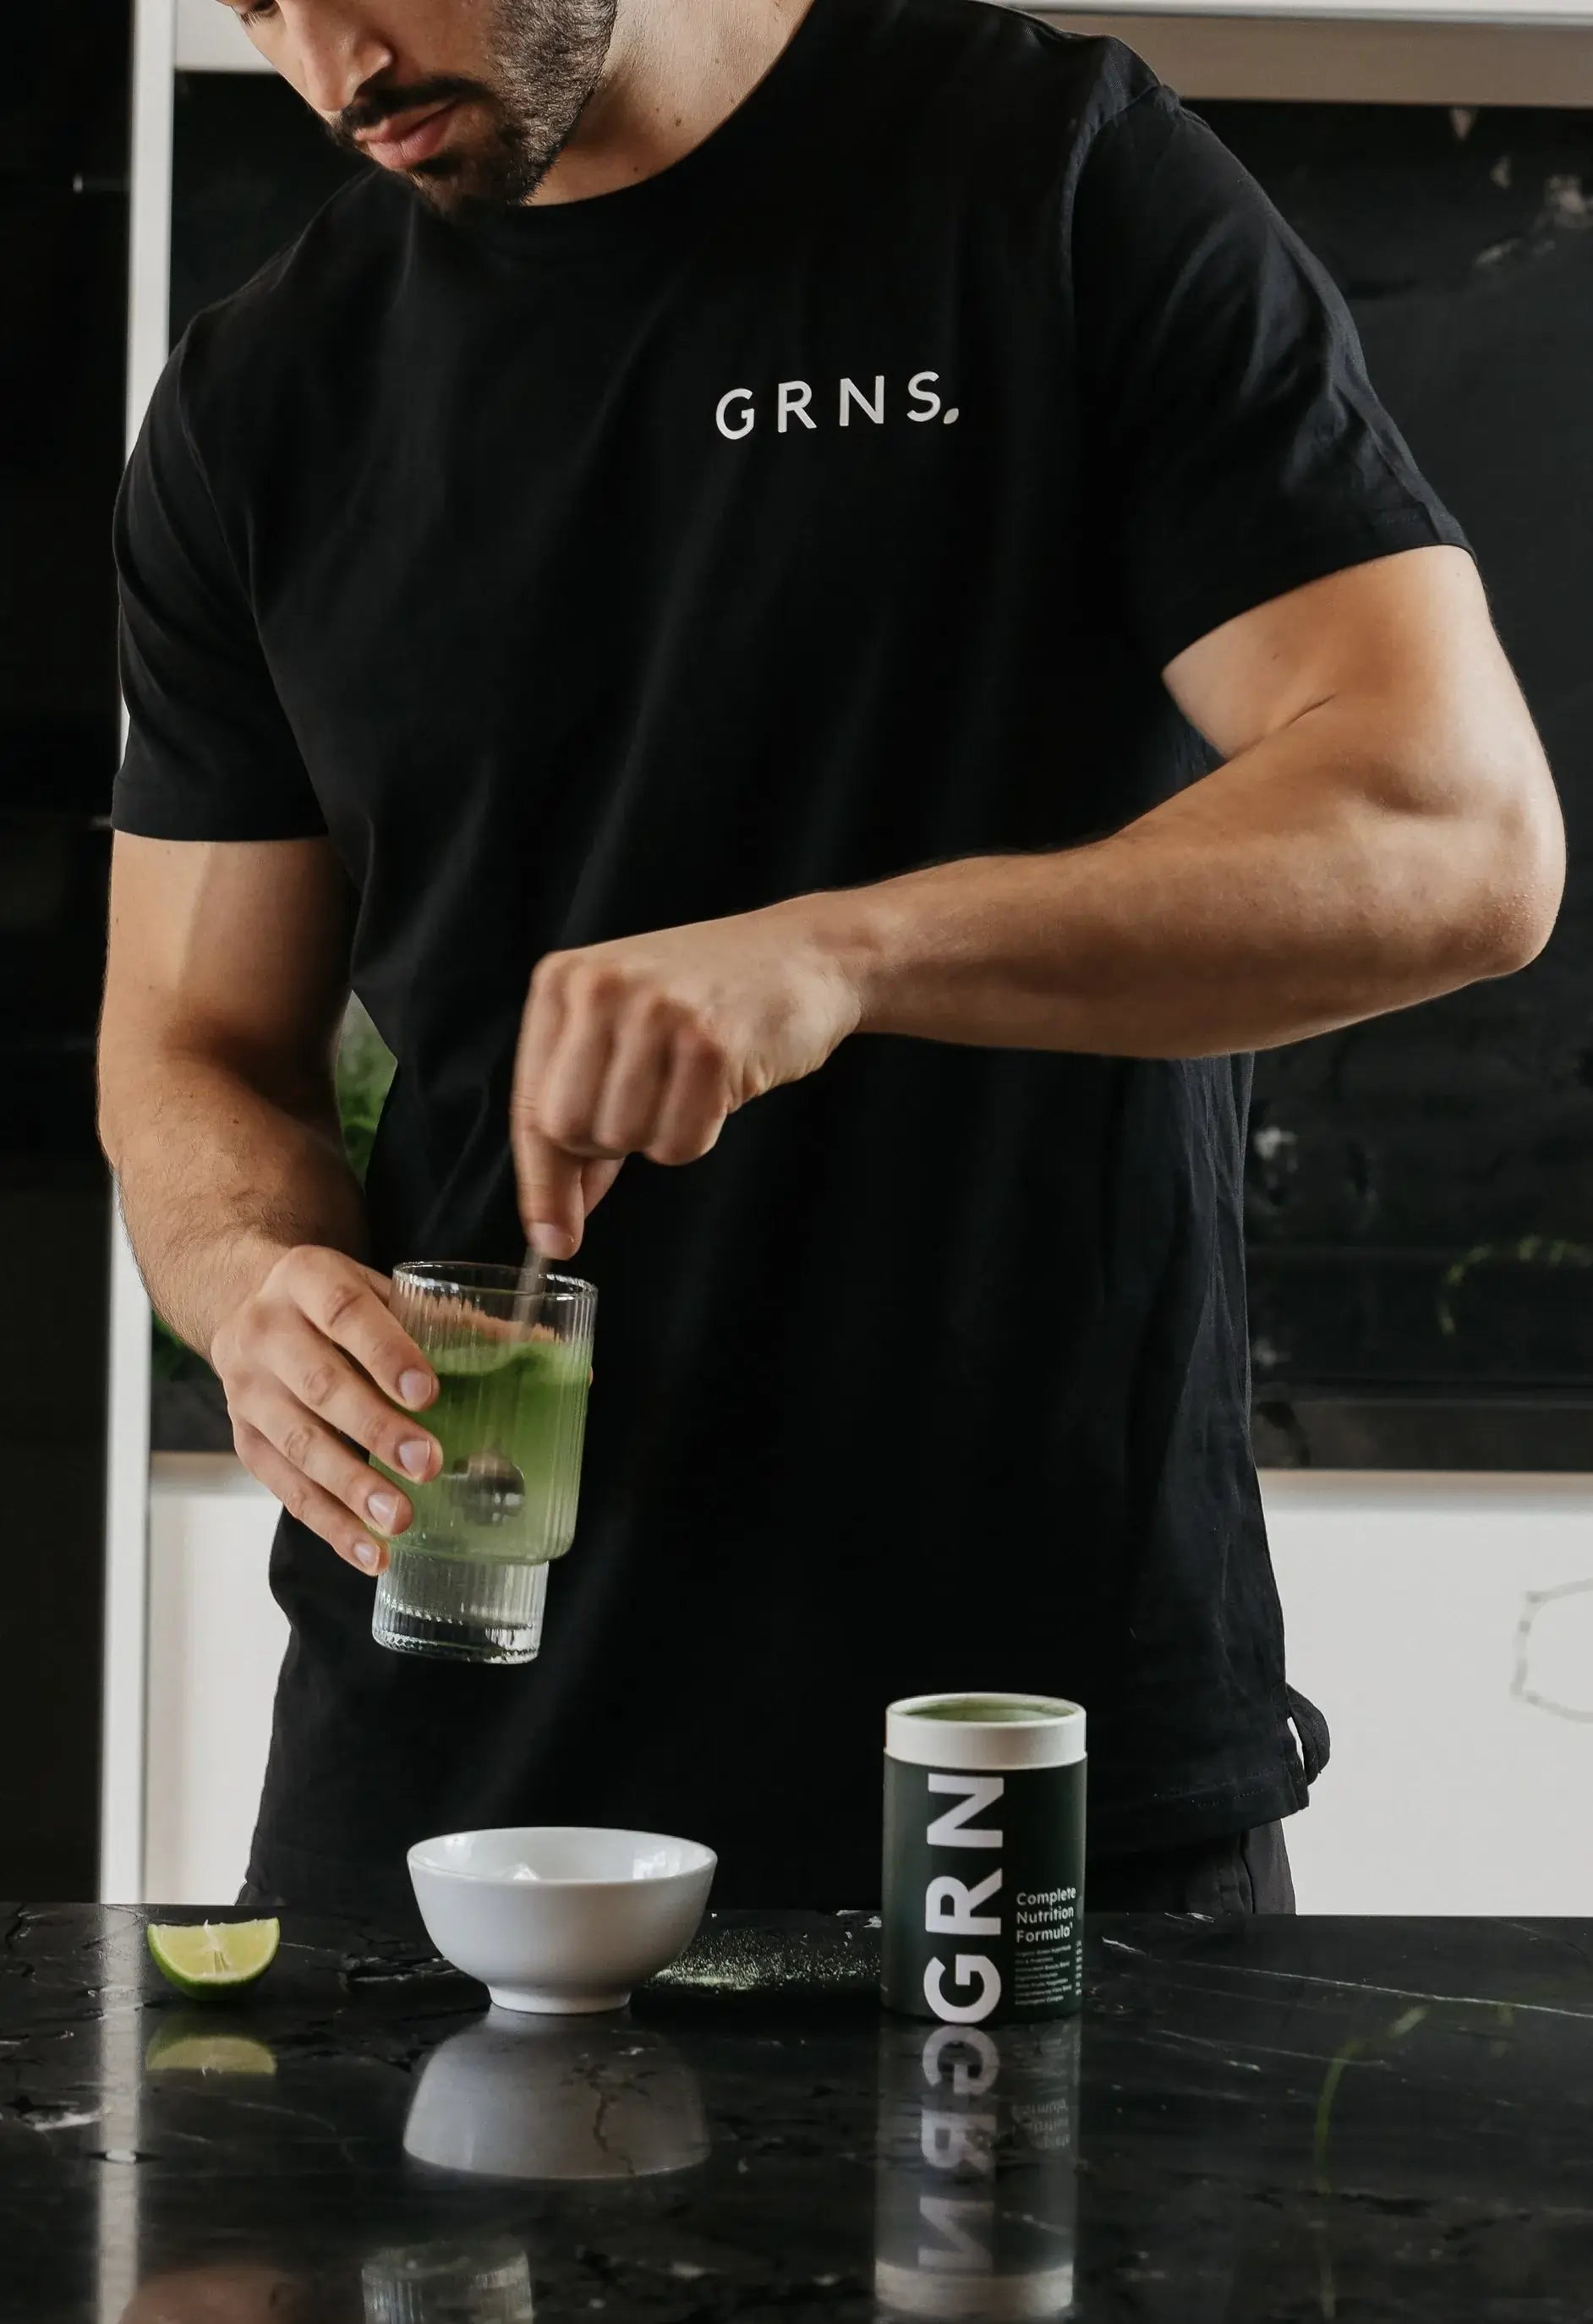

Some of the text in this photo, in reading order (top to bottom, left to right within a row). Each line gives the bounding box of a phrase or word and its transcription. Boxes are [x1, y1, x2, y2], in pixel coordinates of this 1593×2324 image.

[923, 1773, 1005, 2024] GRN
[1016, 1887, 1076, 1906] Complete
[1016, 1905, 1074, 1924] Nutrition
